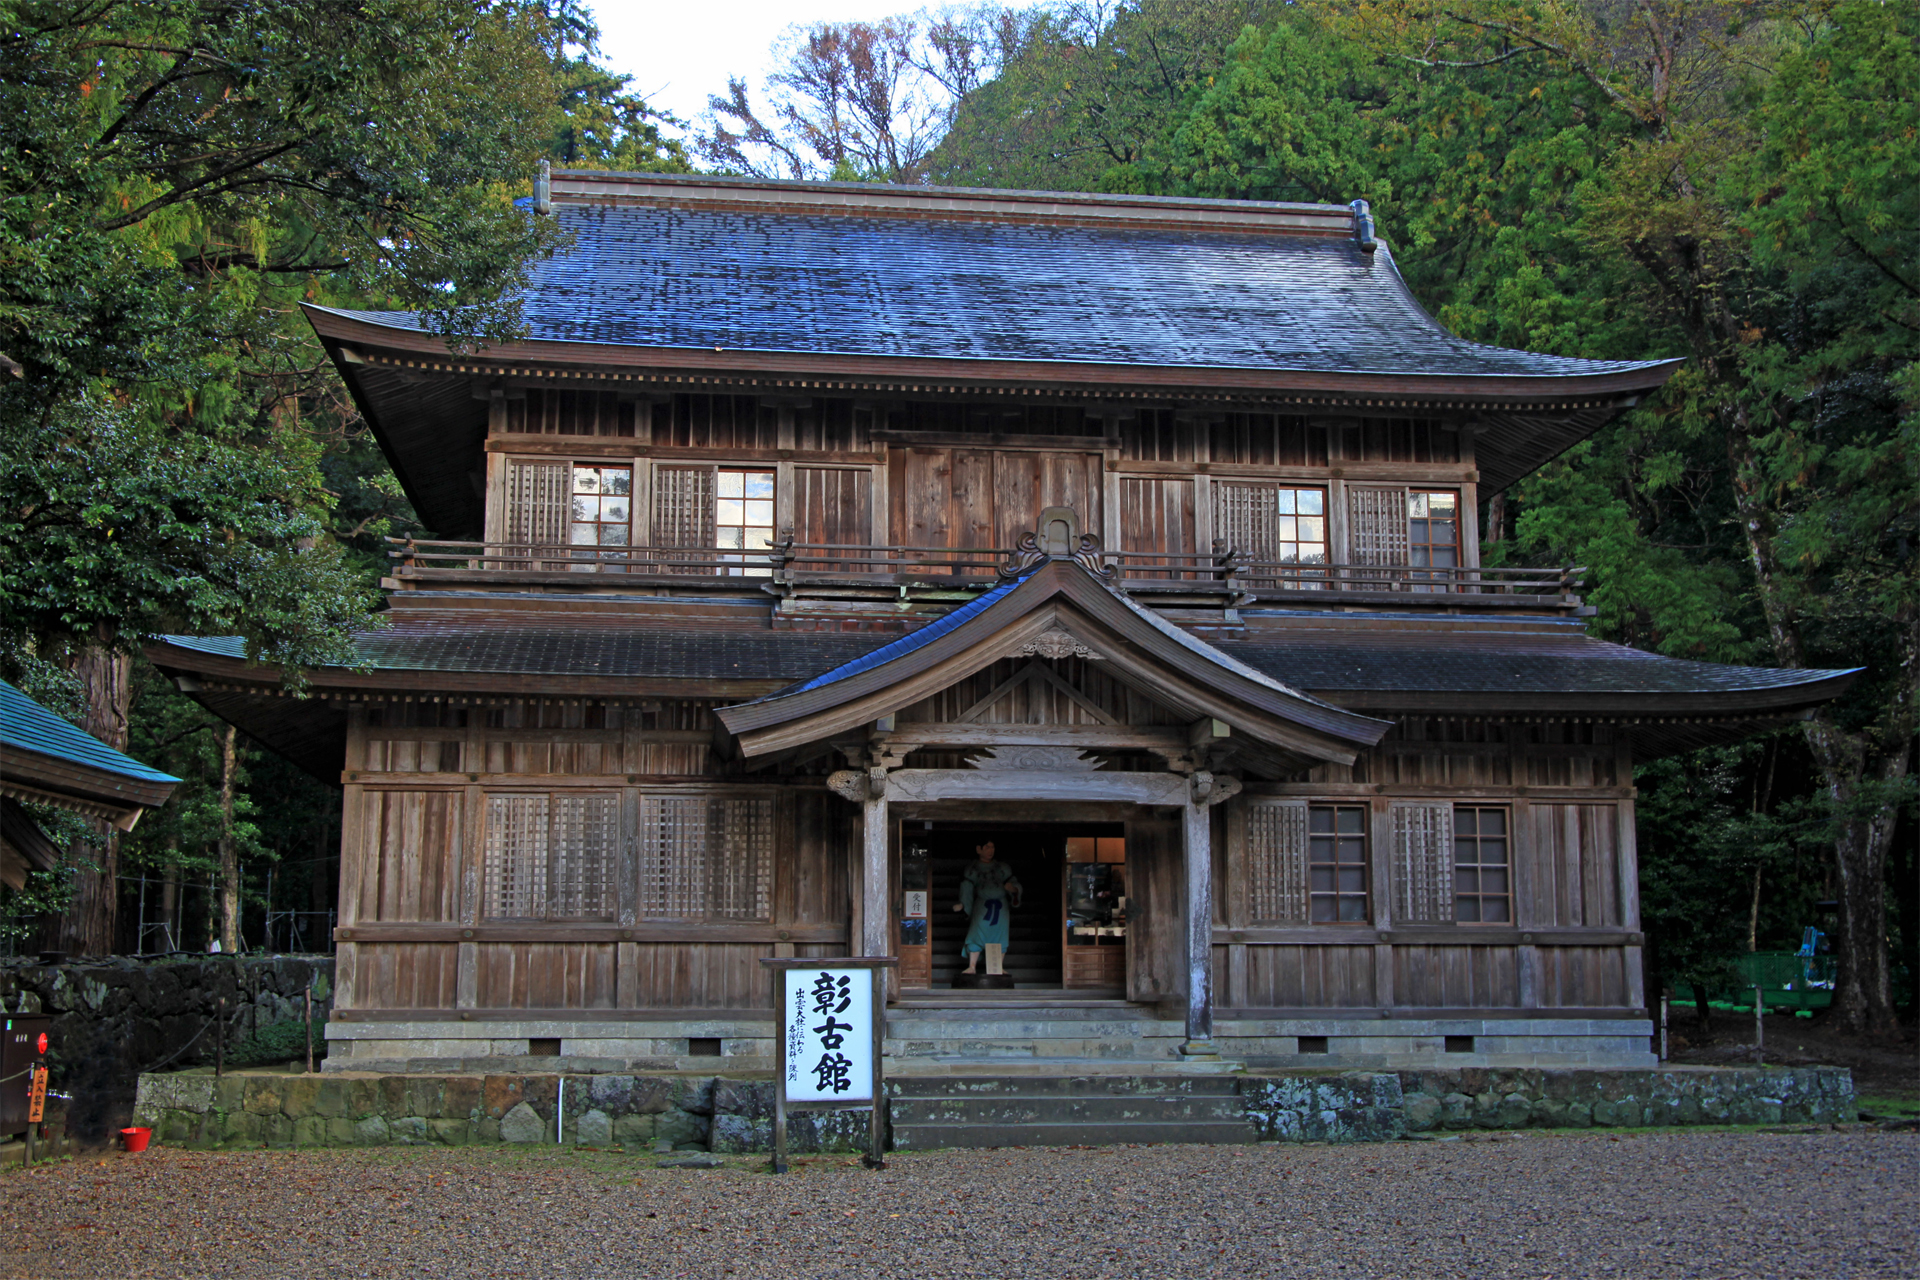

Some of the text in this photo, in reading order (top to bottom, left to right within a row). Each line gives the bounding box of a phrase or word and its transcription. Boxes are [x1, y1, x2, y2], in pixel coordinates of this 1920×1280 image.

[912, 892, 921, 912] 受付
[795, 988, 806, 1054] 出雲大社に伝わる
[810, 971, 853, 1094] 彰古館
[32, 1074, 44, 1116] 立入禁止
